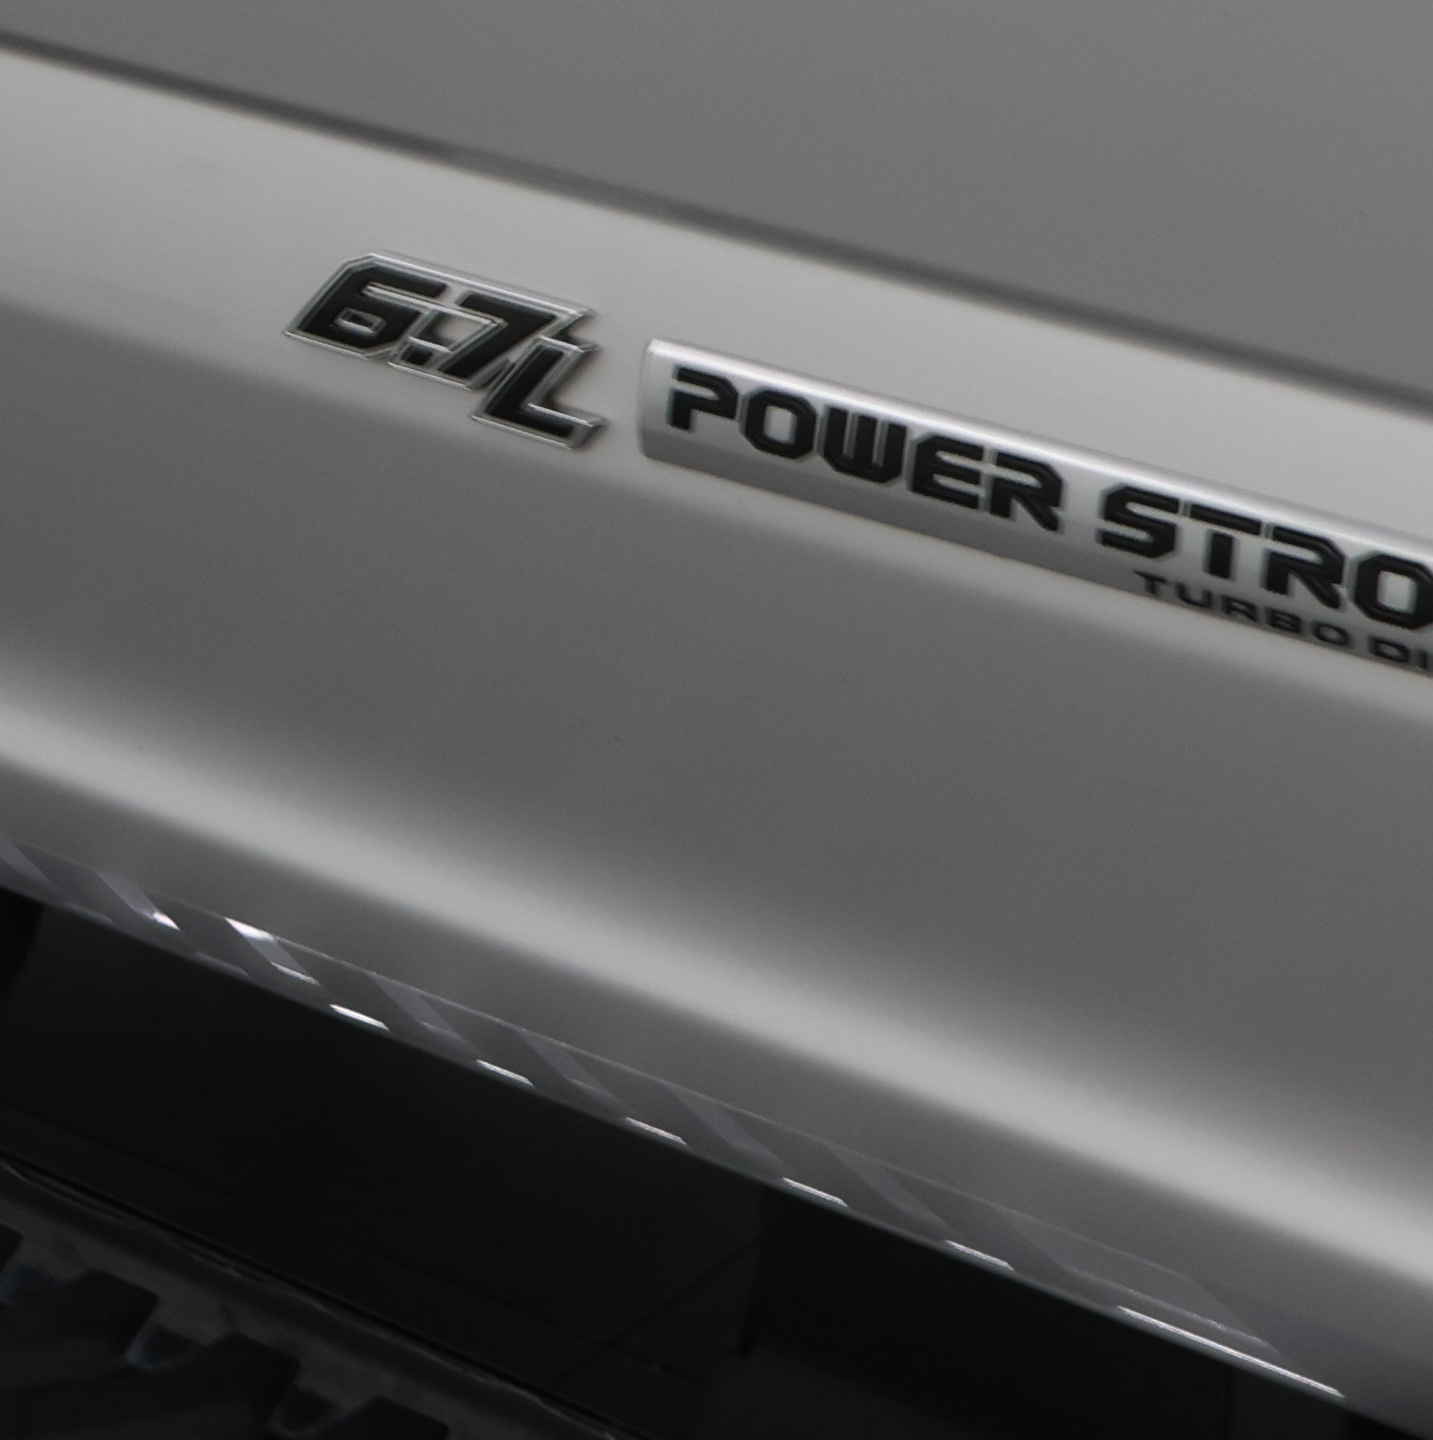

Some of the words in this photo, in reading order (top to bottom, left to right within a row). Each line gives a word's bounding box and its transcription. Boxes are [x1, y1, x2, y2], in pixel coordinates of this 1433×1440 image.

[283, 252, 606, 450] 6.7L
[667, 365, 1064, 532] POWER
[1134, 570, 1352, 647] TURBO
